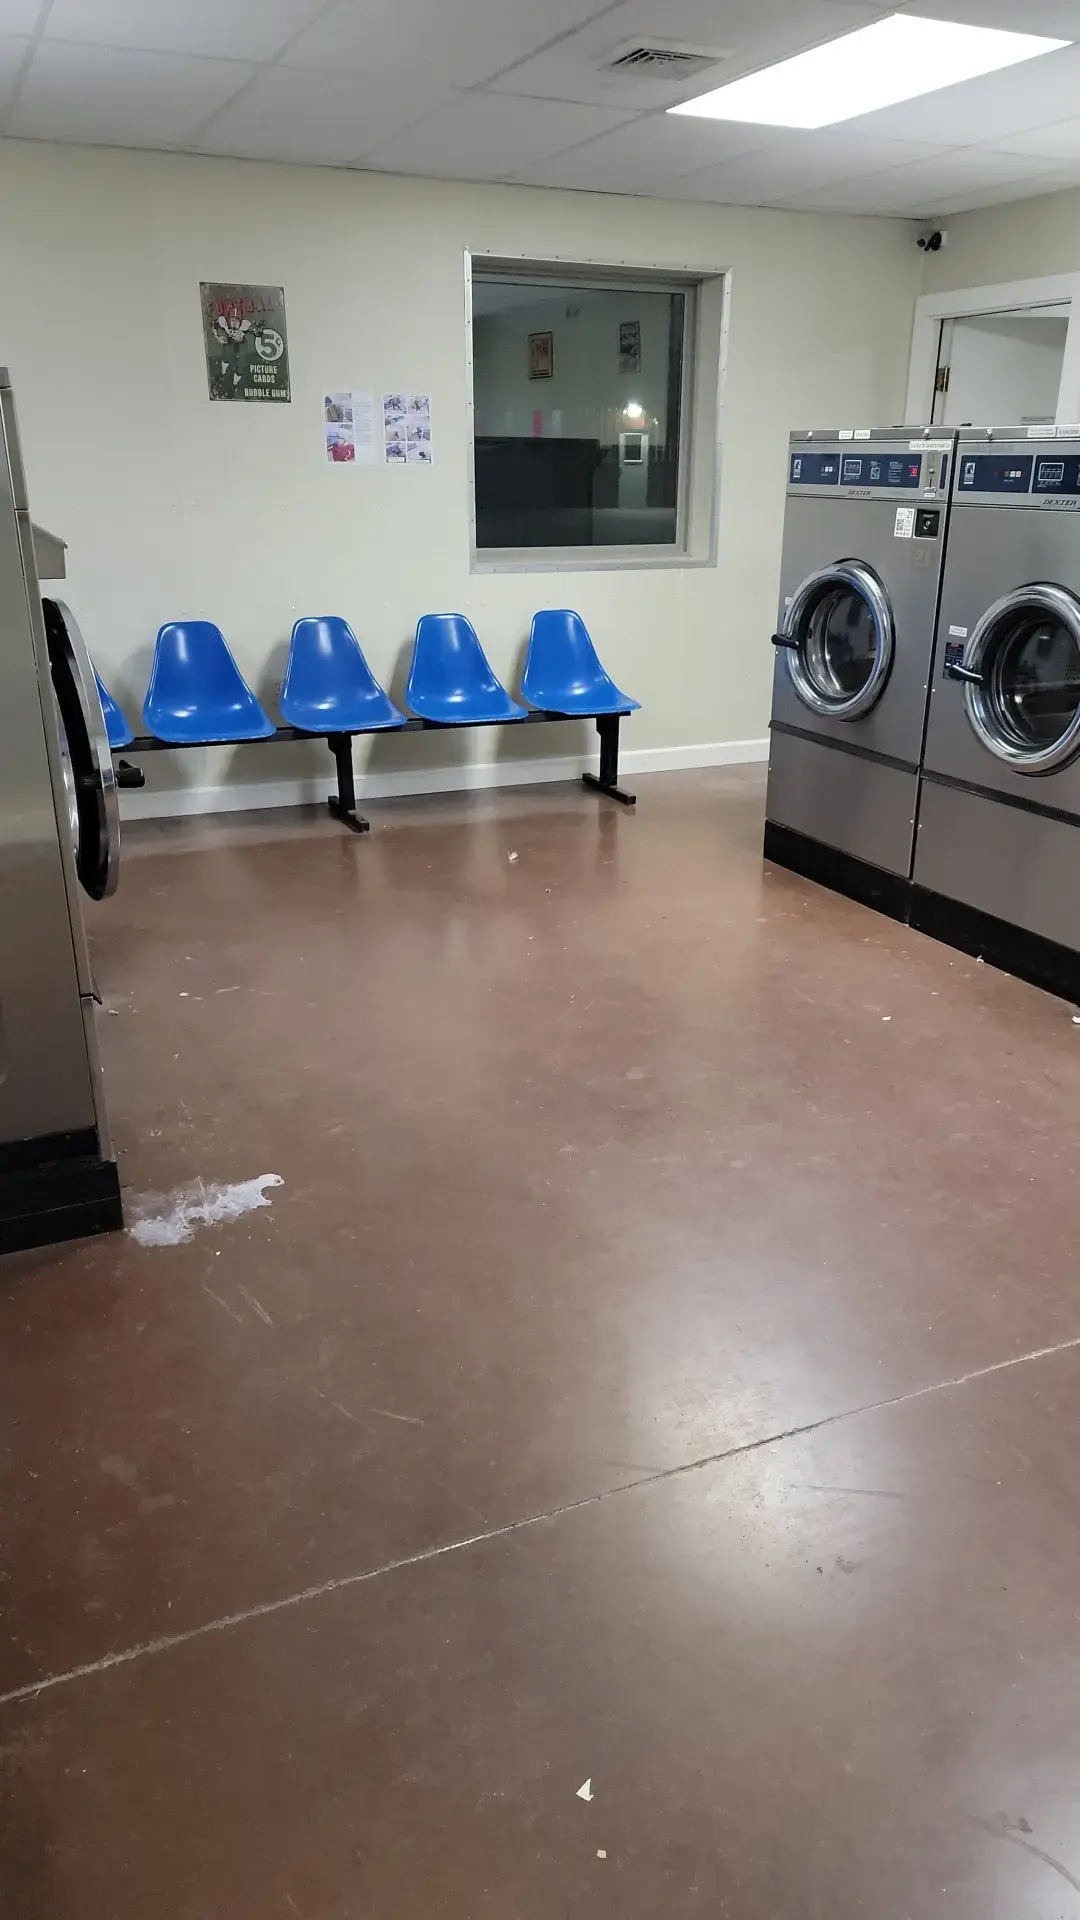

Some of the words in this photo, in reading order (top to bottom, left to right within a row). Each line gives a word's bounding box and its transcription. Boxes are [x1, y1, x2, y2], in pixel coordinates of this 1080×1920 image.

[249, 364, 278, 375] PICTURE
[253, 374, 276, 384] CARDS
[244, 388, 270, 398] BUBBLE
[271, 388, 287, 398] GUM
[1042, 498, 1078, 506] DEXTER
